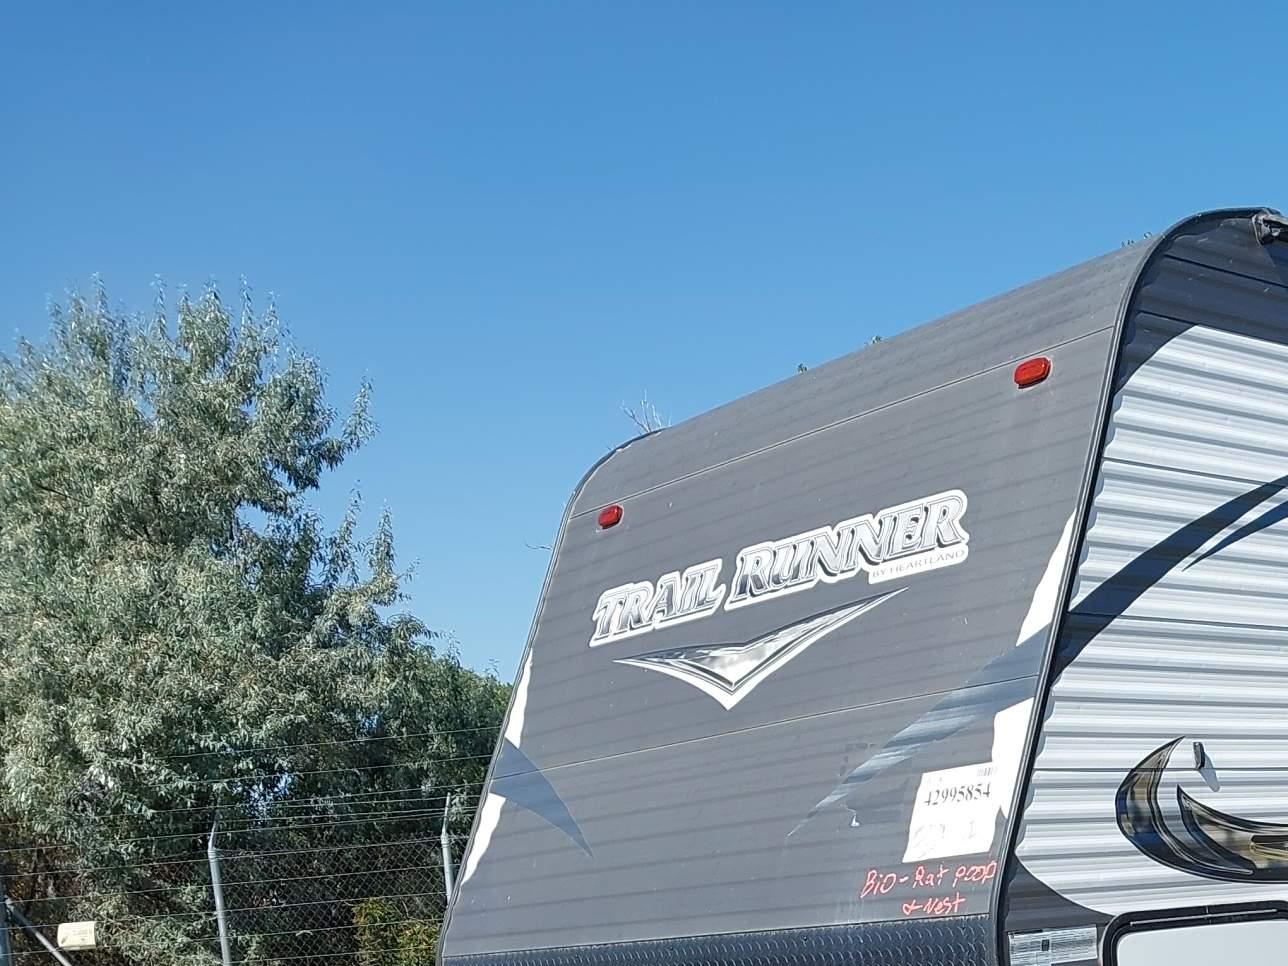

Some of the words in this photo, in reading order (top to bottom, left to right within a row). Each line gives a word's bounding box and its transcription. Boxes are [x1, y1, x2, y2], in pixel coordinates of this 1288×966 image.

[590, 559, 727, 647] TRAIL
[725, 489, 970, 611] RUNNER
[890, 549, 966, 573] HEARTLAND
[924, 783, 991, 806] 42995854
